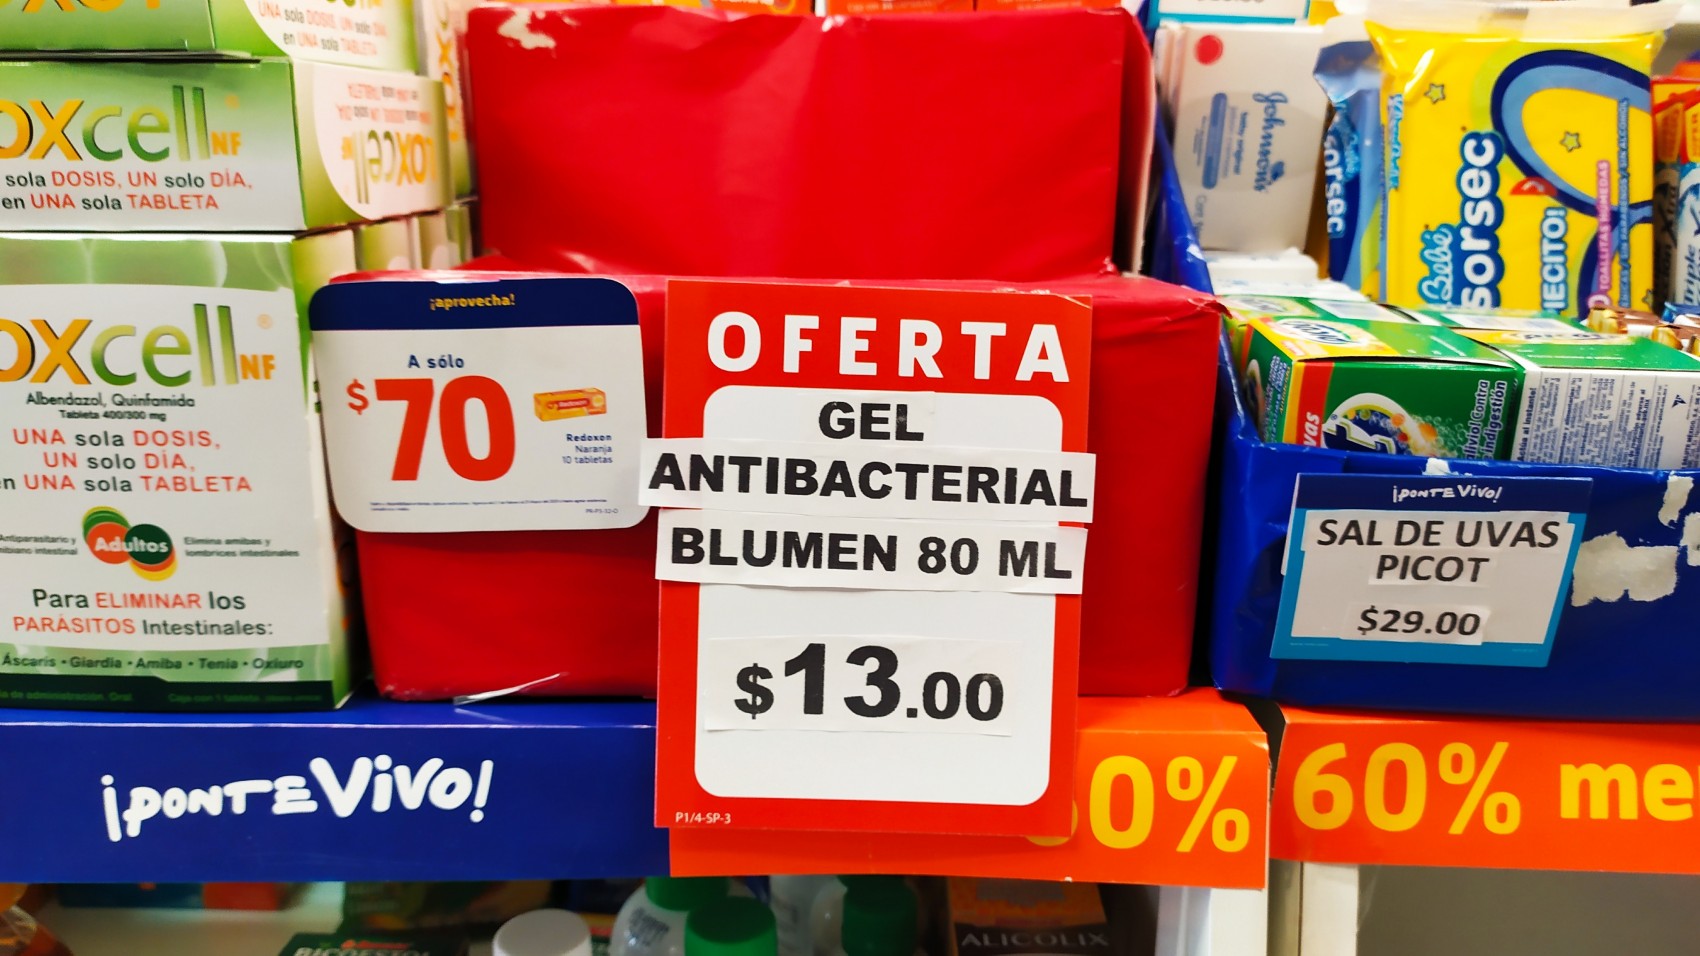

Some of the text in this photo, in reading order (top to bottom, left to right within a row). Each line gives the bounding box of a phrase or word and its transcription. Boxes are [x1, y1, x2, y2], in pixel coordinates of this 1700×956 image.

[211, 132, 242, 156] NF
[6, 171, 46, 188] sola
[128, 172, 157, 187] UN
[164, 172, 205, 188] solo
[2, 194, 219, 211] en UNA sola TABLETA
[1598, 224, 1610, 290] TOALLITAS
[430, 293, 515, 312] ¡aprovecha!
[706, 310, 1070, 383] OFERTA
[240, 354, 276, 381] NF
[408, 353, 465, 369] A sólo
[26, 391, 195, 409] Albendazol, Quinfamida
[1470, 380, 1490, 420] Contra
[59, 410, 167, 423] Tableta 400/300 mg
[818, 400, 925, 442] GEL
[1481, 381, 1508, 453] indigestión
[13, 428, 65, 445] UNA
[74, 430, 125, 447] sola
[345, 374, 516, 482] $70
[566, 433, 612, 442] Redoxon
[43, 452, 78, 468] UN
[87, 453, 136, 470] solo
[562, 455, 613, 465] 10 tabletas
[575, 445, 612, 456] Naranja
[23, 474, 76, 490] UNA
[84, 475, 133, 492] sola
[140, 475, 253, 492] TABLETA
[647, 452, 1088, 508] ANTIBACTERIAL
[183, 536, 223, 546] Elimina
[224, 537, 263, 547] amibas
[1316, 518, 1560, 548] SAL DE UVAS
[94, 536, 170, 554] Adultos
[184, 549, 300, 558] lombrices intestinales
[670, 526, 1073, 580] BLUMEN 80 ML
[1375, 554, 1490, 583] PICOT
[33, 588, 247, 610] Para ELIMINAR los
[13, 612, 274, 636] PARÁSITOS Intestinales:
[1357, 605, 1481, 636] $29.00
[69, 655, 122, 669] Giardia
[135, 656, 183, 670] Amiba
[198, 656, 239, 670] Tenia
[252, 656, 304, 671] Oxiuro
[733, 642, 1005, 722] $13.00
[1292, 741, 1522, 836] 60%
[1559, 762, 1700, 822] me
[1025, 755, 1250, 854] 0%
[674, 811, 732, 825] P1/4-SP-3
[961, 932, 1110, 947] ALICOLIX
